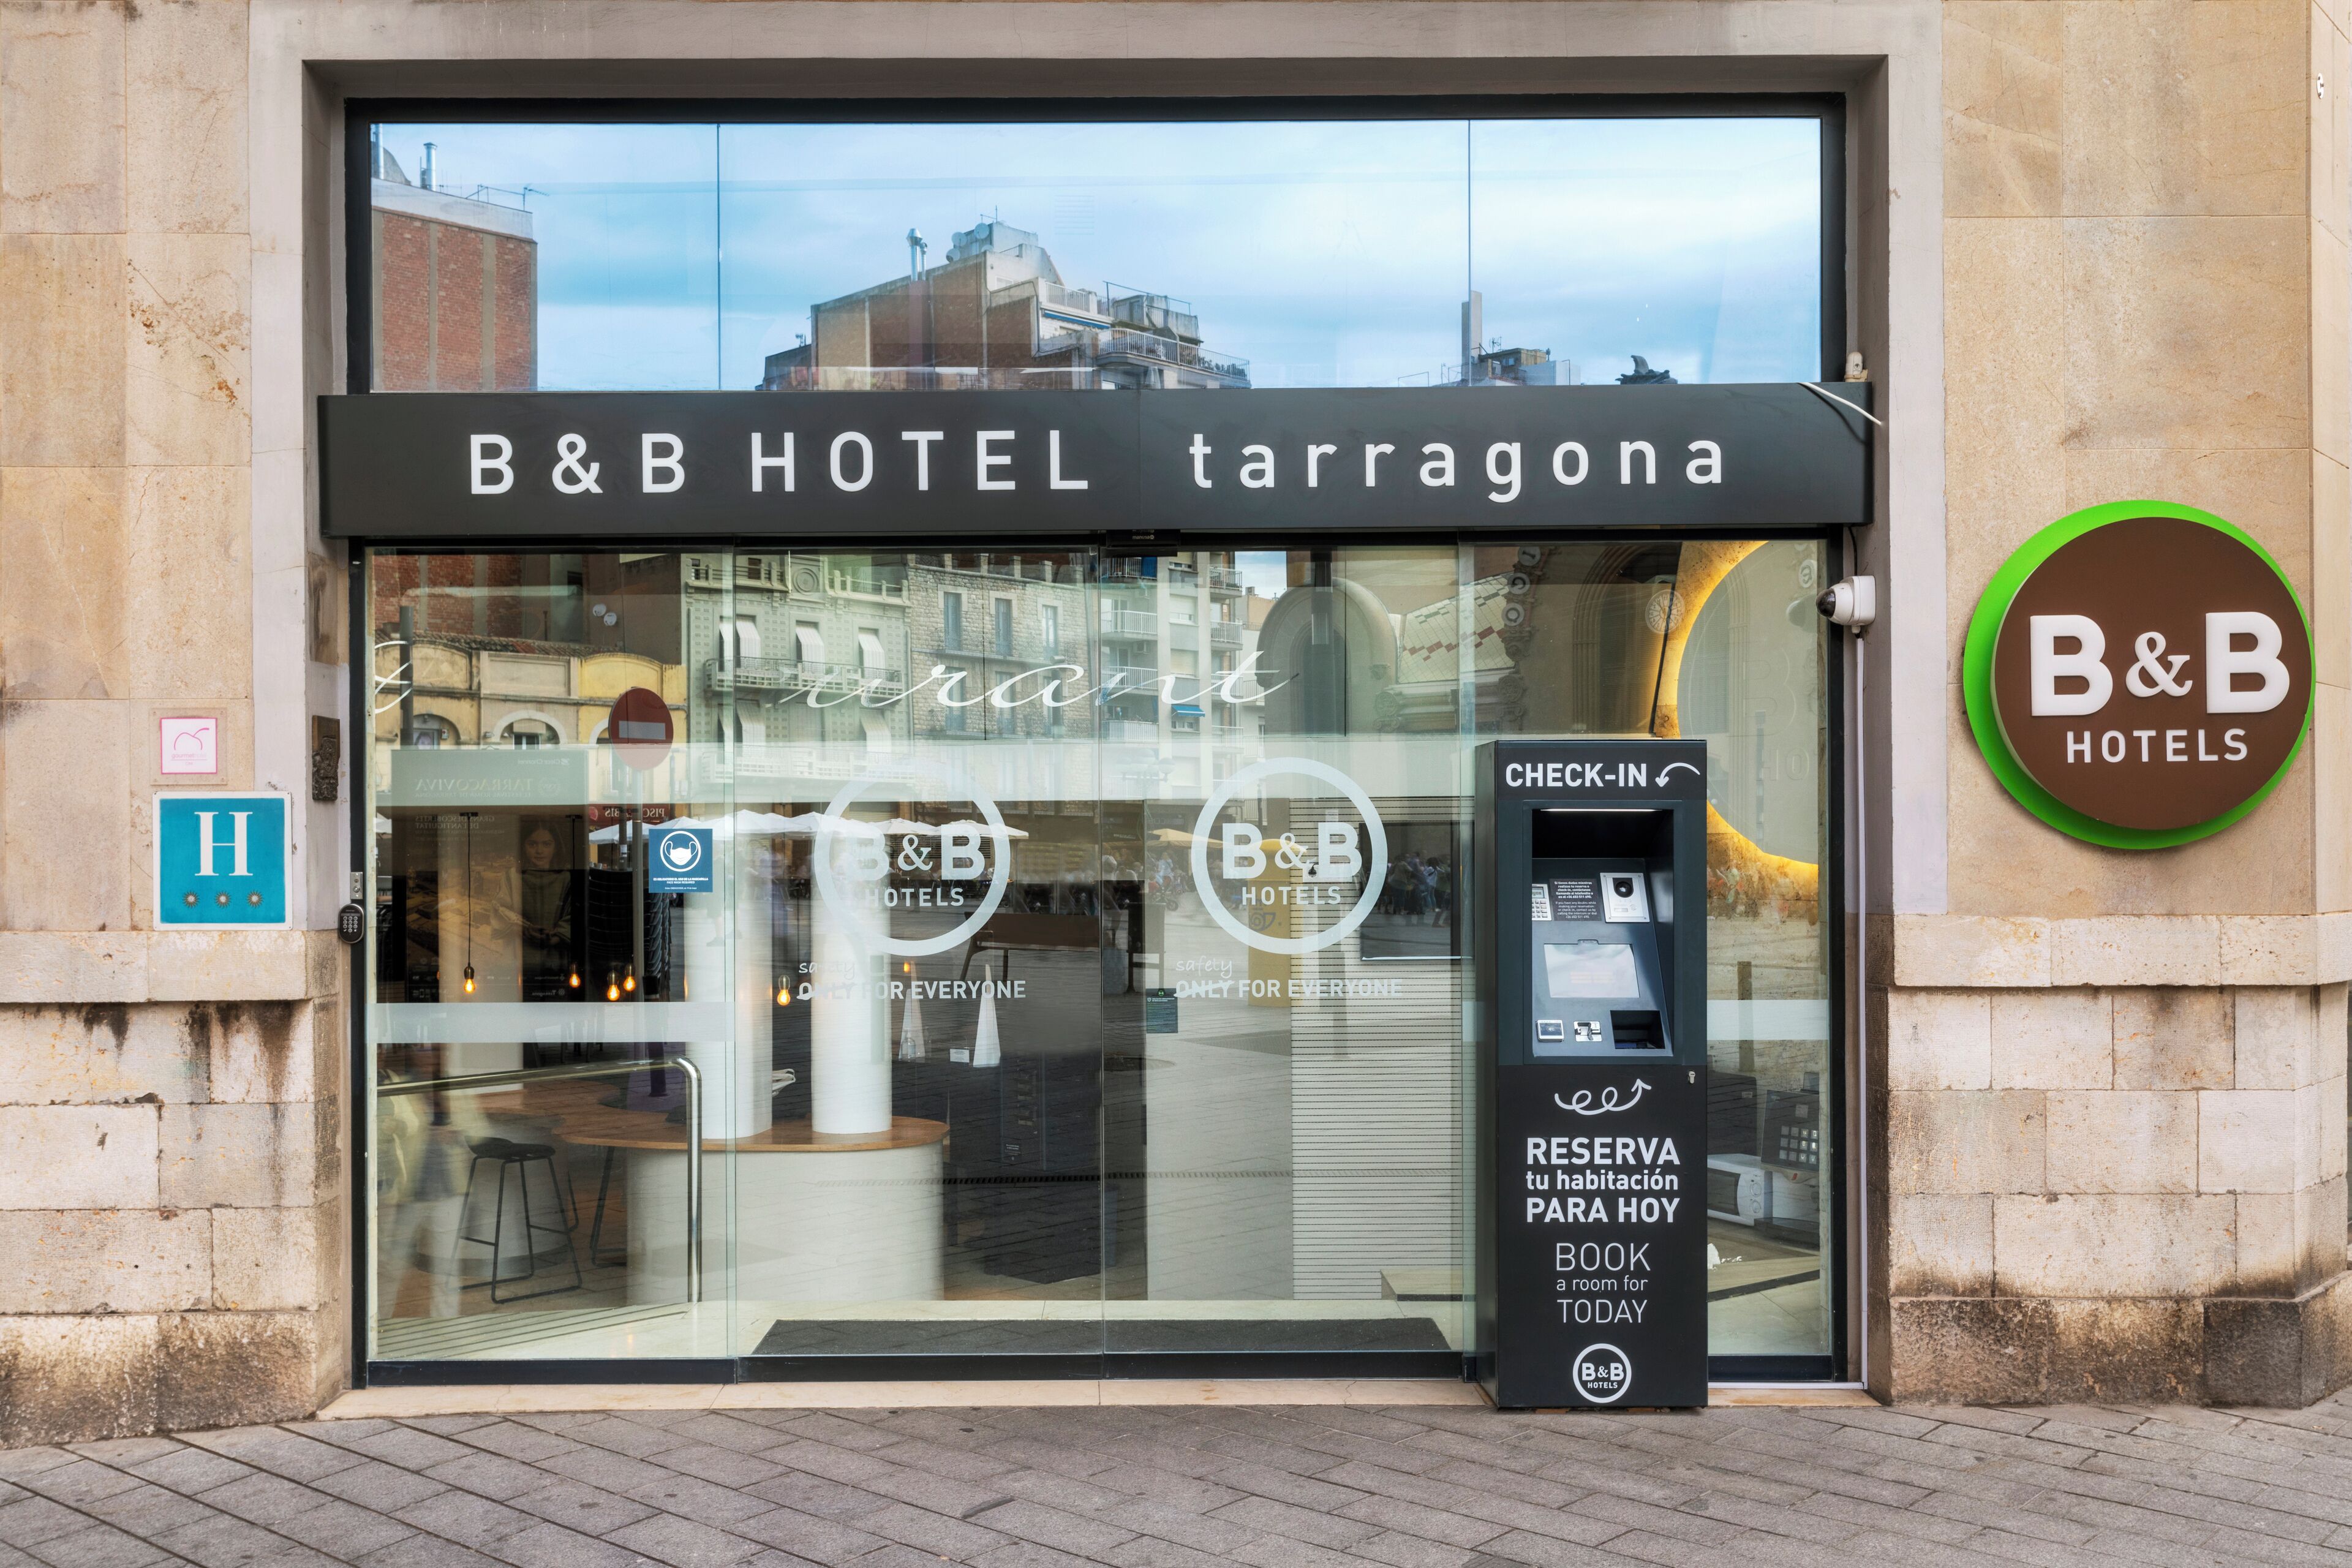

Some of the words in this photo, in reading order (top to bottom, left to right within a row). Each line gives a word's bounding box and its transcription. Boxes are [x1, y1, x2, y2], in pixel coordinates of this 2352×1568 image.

[470, 434, 514, 494] B
[552, 433, 603, 494] &
[642, 434, 685, 493] B
[750, 430, 1088, 493] HOTEL
[1189, 434, 1722, 502] tarragona
[2030, 611, 2290, 716] B&B
[2067, 729, 2247, 763] HOTELS
[1506, 763, 1646, 787] CHECK-IN
[194, 812, 254, 876] H
[846, 824, 985, 880] B&B
[1223, 822, 1363, 879] B&B
[865, 888, 964, 907] HOTELS
[1242, 886, 1341, 905] HOTELS
[1175, 956, 1233, 978] safety
[862, 981, 904, 1000] FOR
[911, 980, 1026, 999] EVERYONE
[1173, 980, 1235, 998] ONLY
[1238, 980, 1281, 998] FOR
[1288, 979, 1403, 997] EVERYONE
[1527, 1137, 1681, 1164] RESERVA
[1526, 1171, 1548, 1189] tu
[1557, 1169, 1678, 1190] habitación
[1527, 1197, 1608, 1223] PARA
[1618, 1197, 1680, 1223] HOY
[1556, 1243, 1651, 1271] BOOK
[1556, 1280, 1566, 1291] a
[1573, 1280, 1617, 1291] room
[1624, 1275, 1648, 1291] for
[1557, 1300, 1648, 1323] TODAY
[1581, 1363, 1624, 1381] B&B
